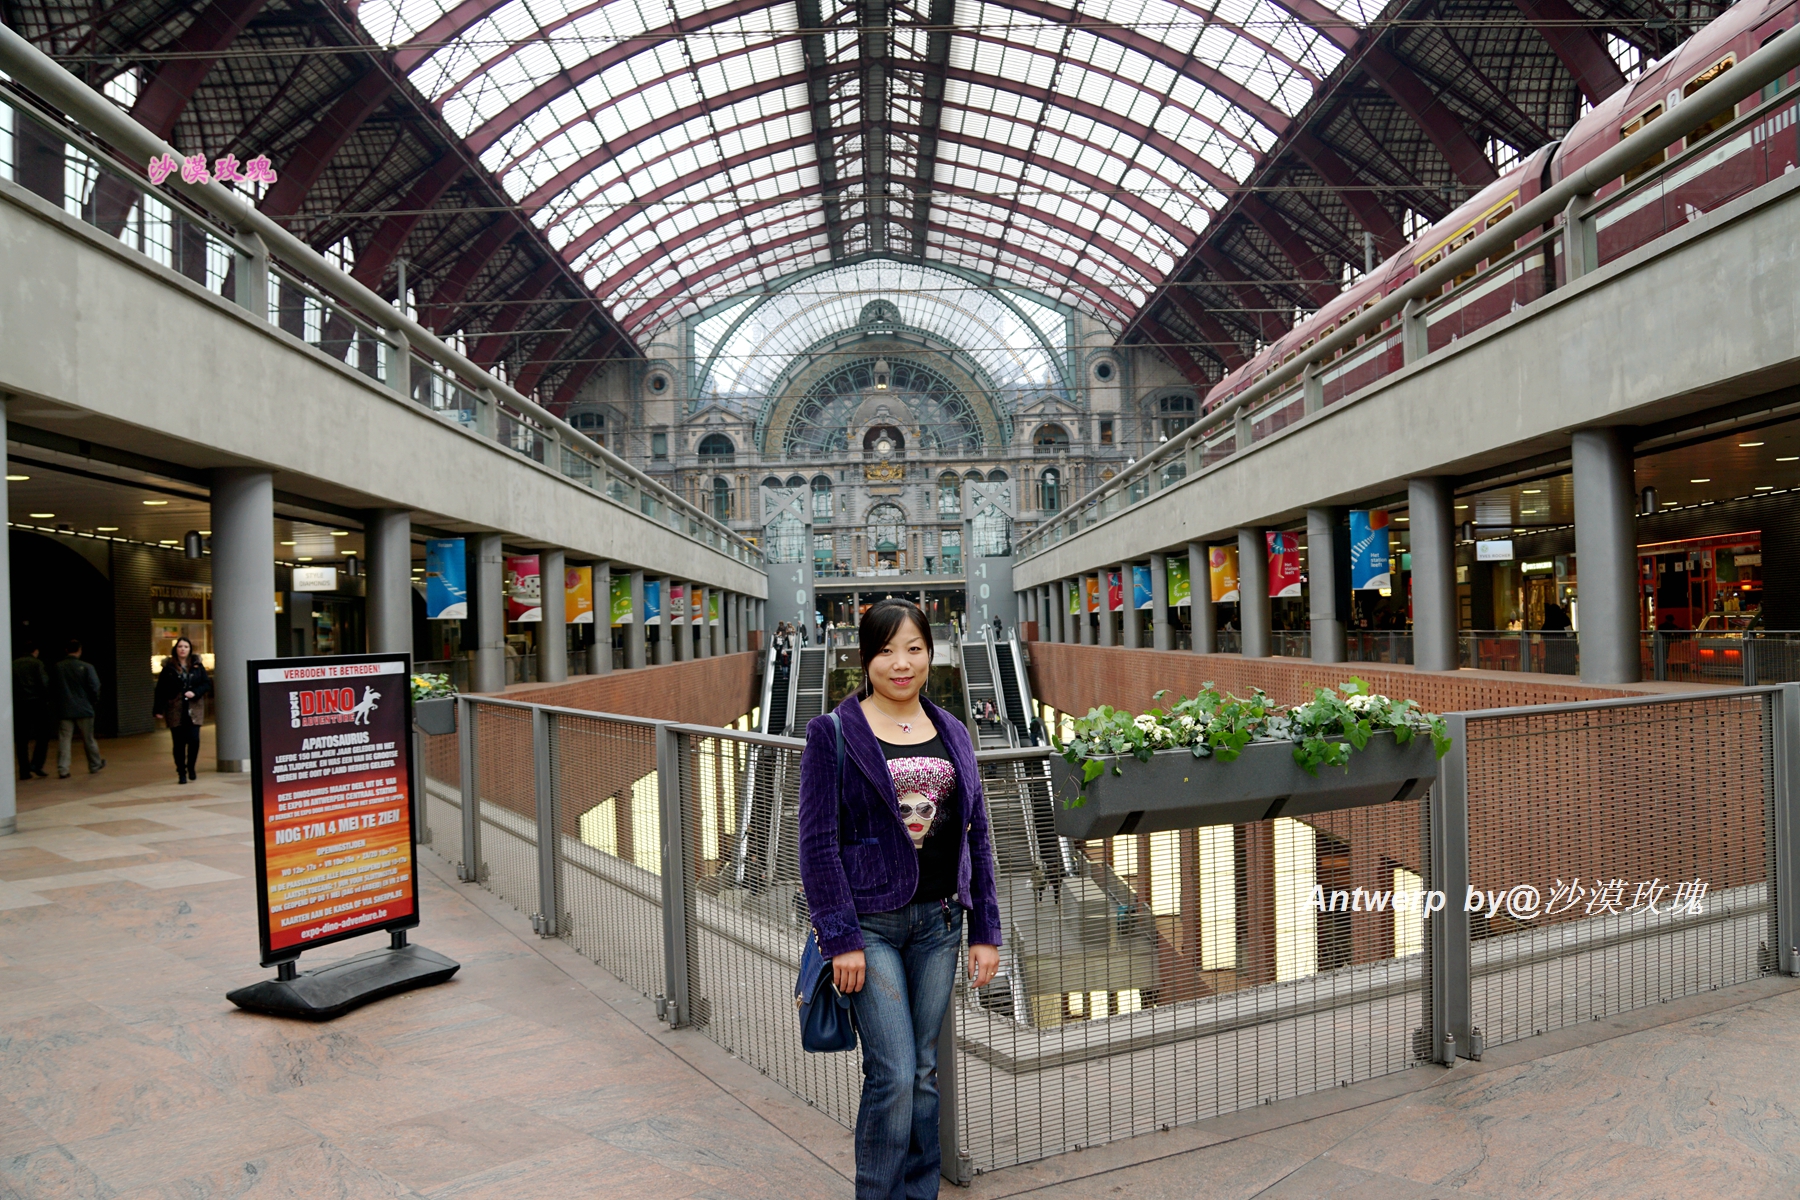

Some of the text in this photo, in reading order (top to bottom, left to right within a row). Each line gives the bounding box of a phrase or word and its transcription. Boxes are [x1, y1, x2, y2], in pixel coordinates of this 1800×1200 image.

[796, 589, 807, 605] 0
[979, 583, 990, 599] 0
[284, 664, 381, 680] VERBODEN TE BETREDEN!
[289, 691, 301, 729] EXPO
[299, 687, 355, 717] DINO
[302, 713, 355, 727] ADVENTURE
[302, 731, 370, 751] APATOSAURUS
[274, 809, 400, 845] NOG T/M 4 MEI TE ZIEN
